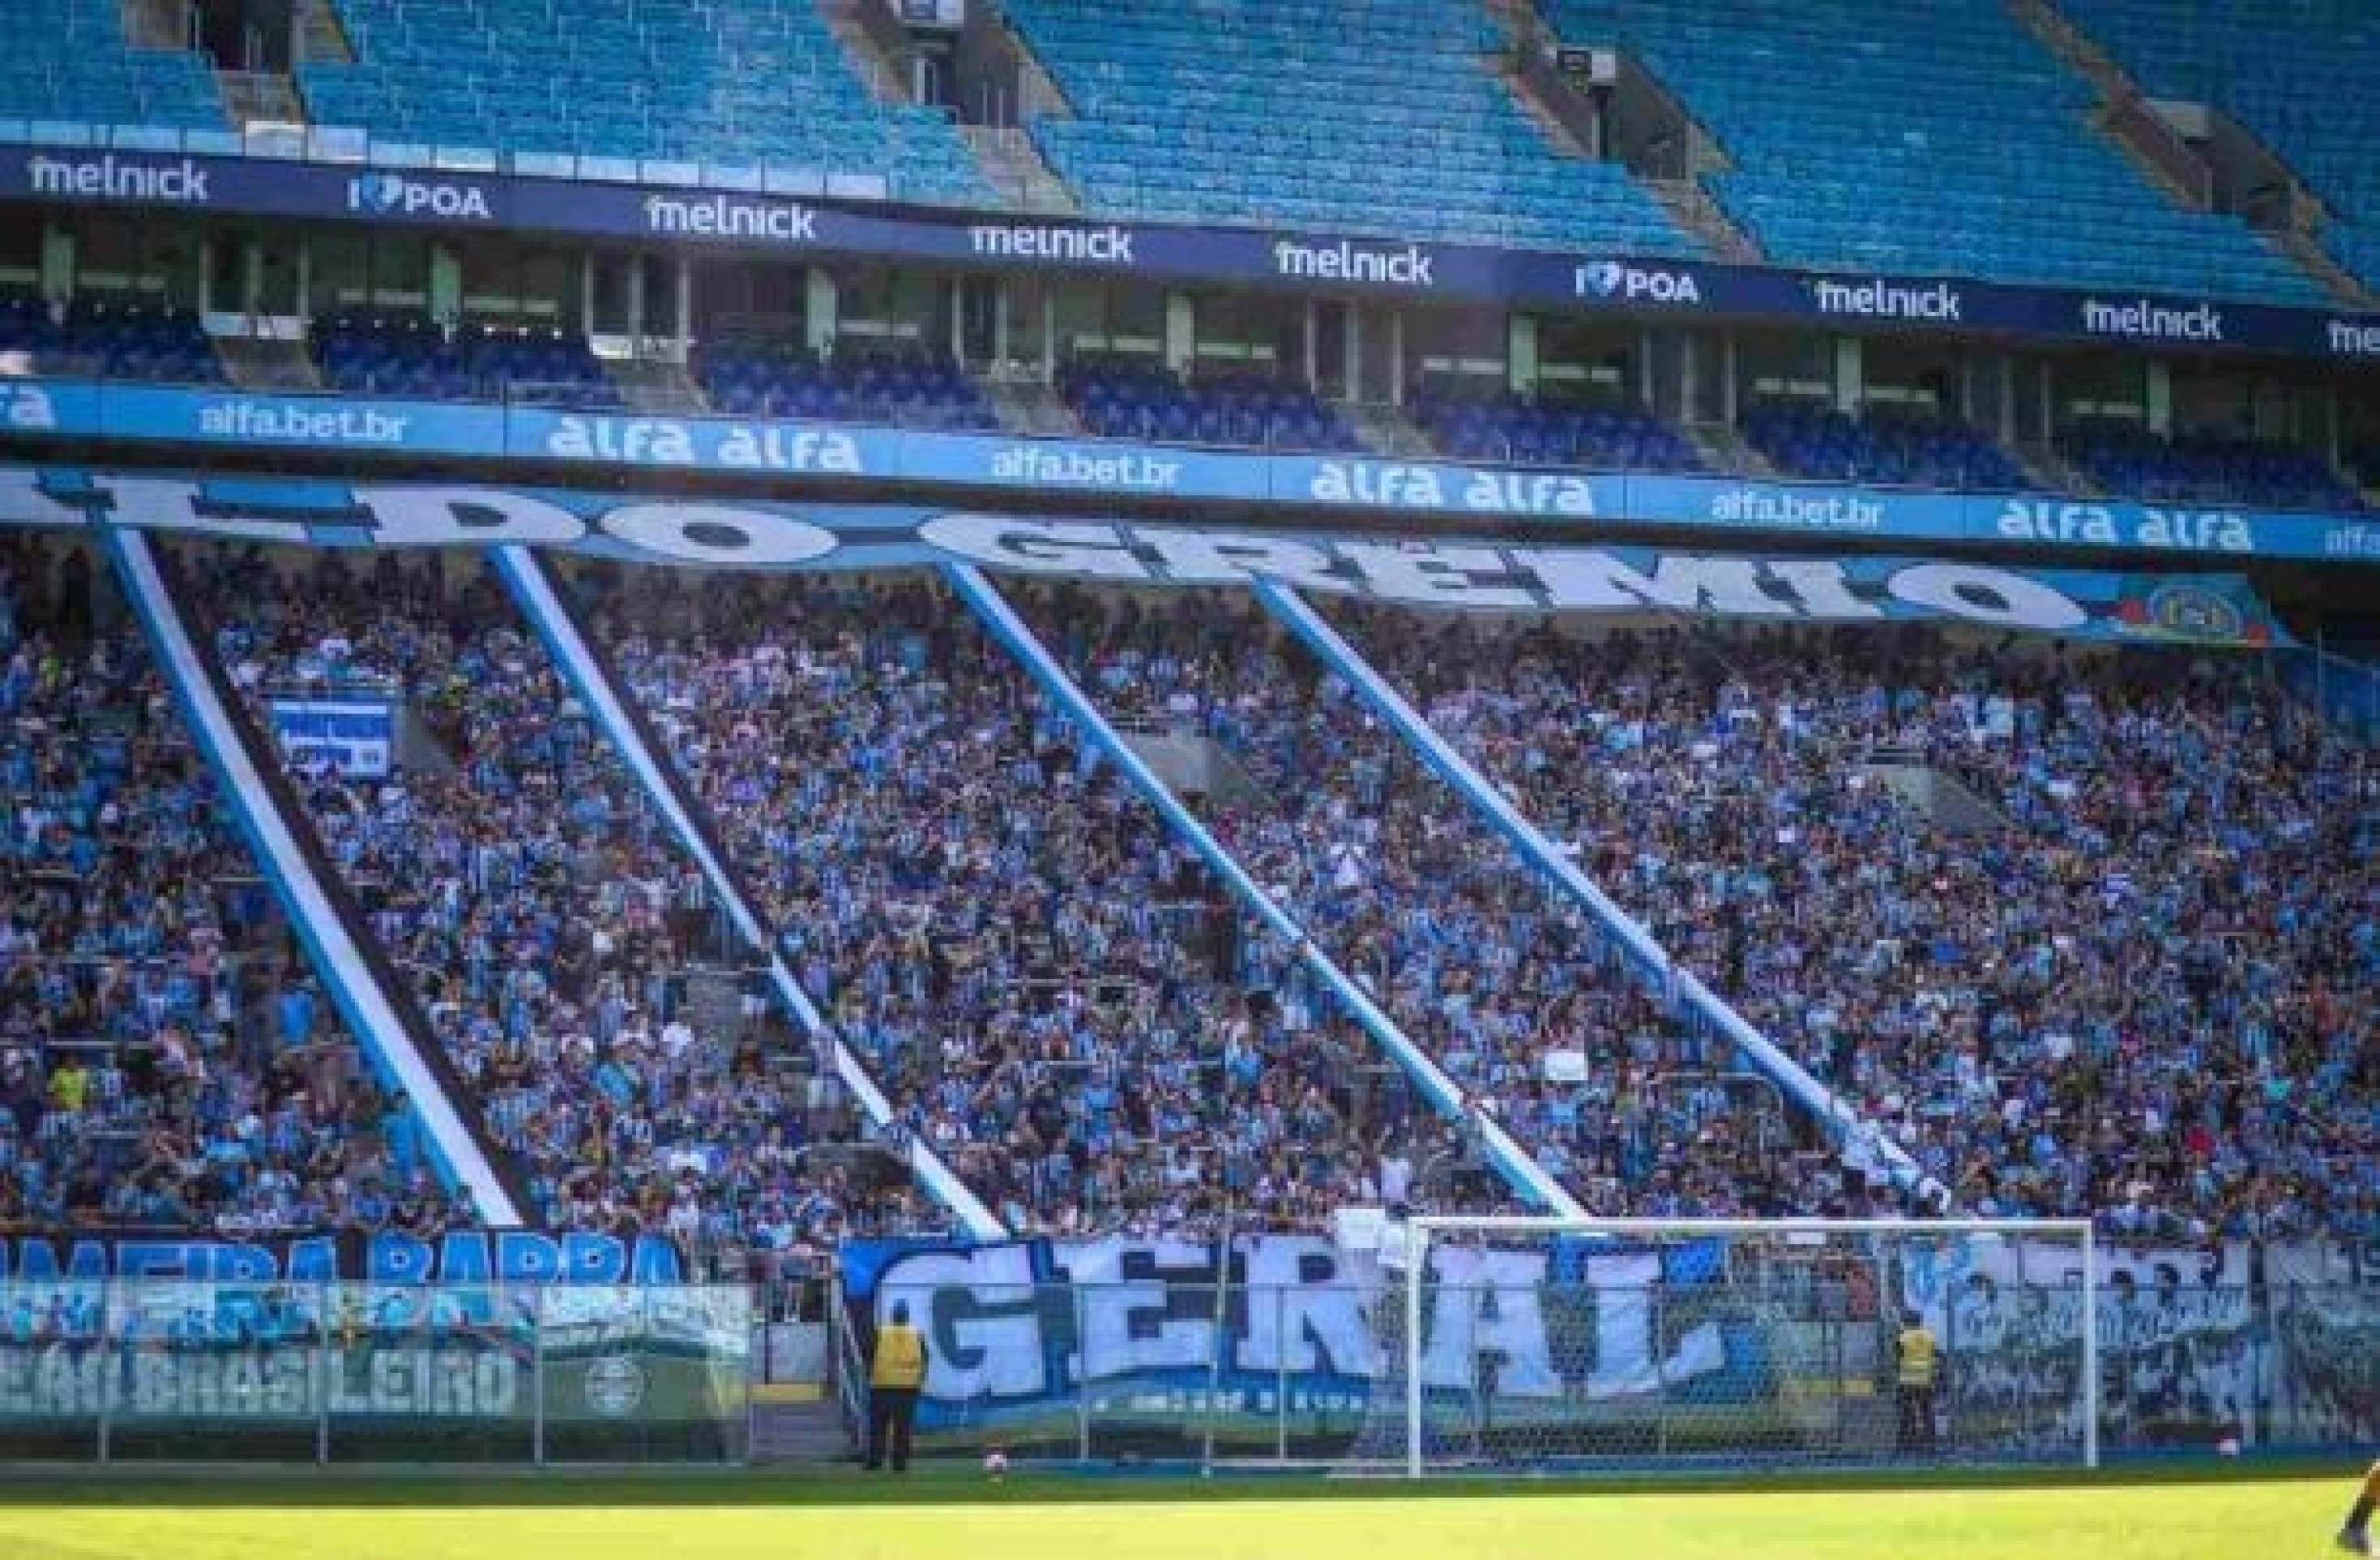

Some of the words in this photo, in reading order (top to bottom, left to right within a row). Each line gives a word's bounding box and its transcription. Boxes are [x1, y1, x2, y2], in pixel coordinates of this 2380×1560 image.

[29, 154, 208, 202] melnick
[405, 182, 489, 219] POA
[648, 193, 817, 240] melnick
[972, 224, 1133, 263] melnick
[1276, 240, 1433, 286] melnick
[1626, 269, 1698, 302] POA
[1814, 280, 1960, 321] melnick
[2083, 300, 2222, 341] melnick
[199, 402, 408, 442] alfa.bet.br
[549, 417, 694, 464] alfa
[718, 425, 862, 472] alfa
[991, 448, 1179, 488] alfa.bet.br
[1310, 463, 1443, 507] alfa
[1462, 472, 1593, 515] alfa
[348, 486, 840, 564] DO
[1711, 487, 1884, 528] alfa.bet.br
[1997, 499, 2119, 543] alfa
[2137, 510, 2253, 551] alfa
[876, 1228, 1726, 1402] GERAL
[134, 1349, 517, 1414] BRASILEIRO
